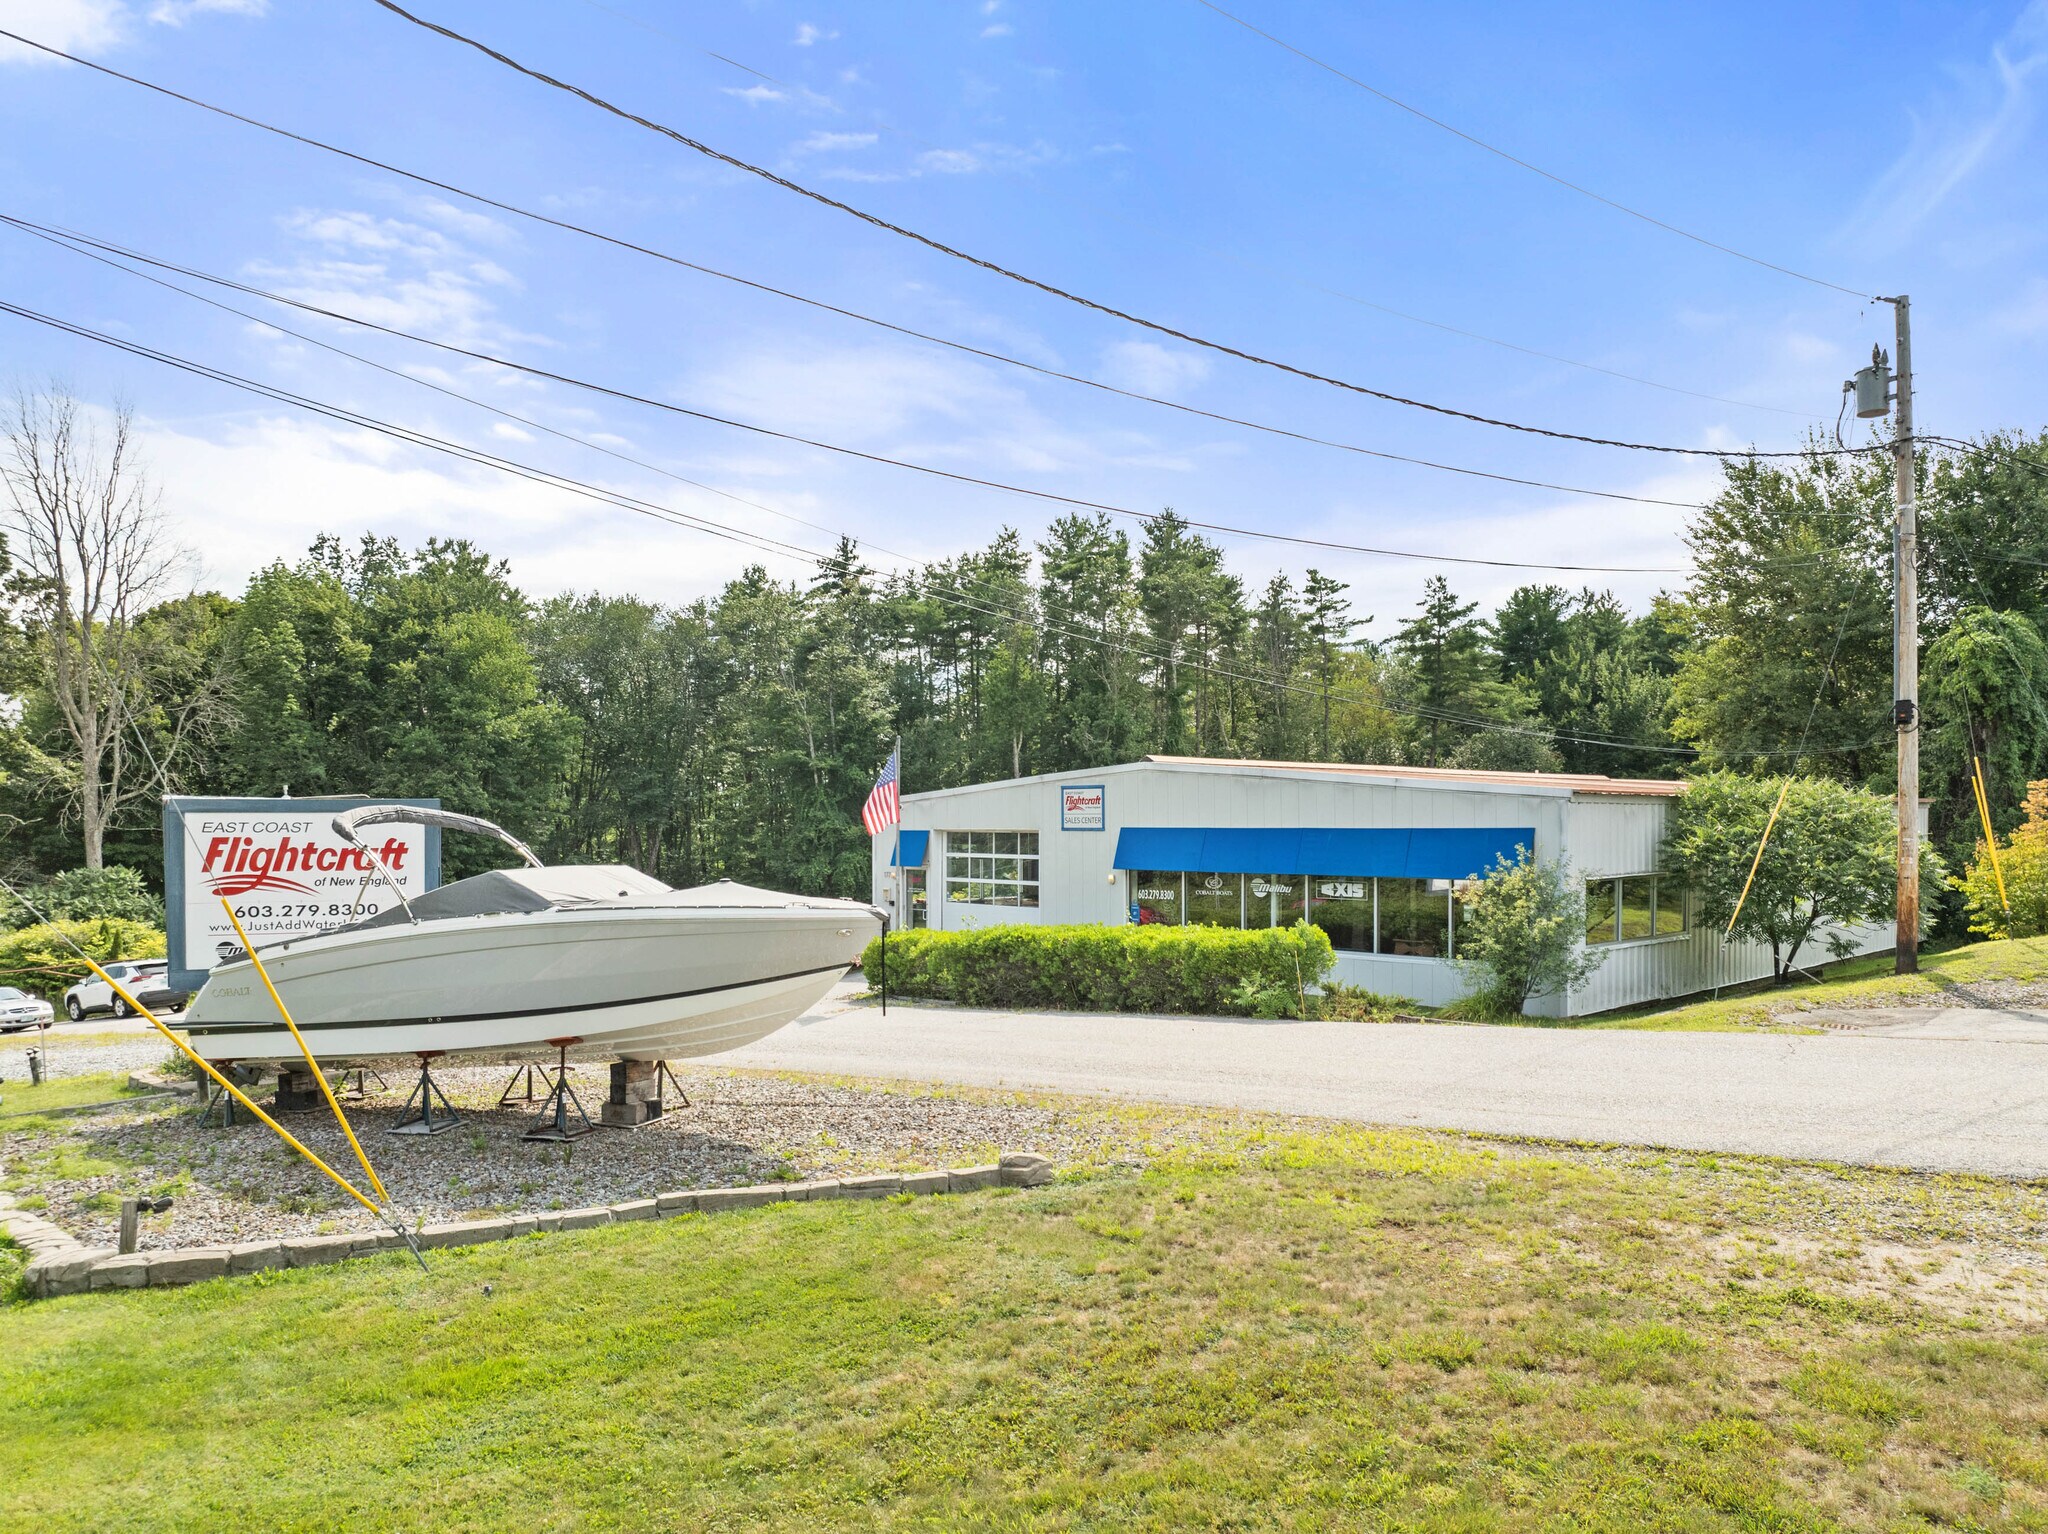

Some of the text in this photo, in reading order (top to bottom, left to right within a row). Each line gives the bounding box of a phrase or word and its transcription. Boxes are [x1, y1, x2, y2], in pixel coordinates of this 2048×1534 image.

[1065, 795, 1101, 811] Flightcraft
[1064, 816, 1102, 824] SALES CENTER
[201, 822, 313, 833] EAST COAST
[201, 837, 409, 896] Flightcraft
[314, 877, 327, 886] of
[329, 876, 355, 886] New
[1138, 889, 1175, 900] 603.279.8300
[1321, 882, 1364, 898] AXIS
[234, 903, 379, 918] 603.279.8300
[211, 987, 251, 998] COBALT
